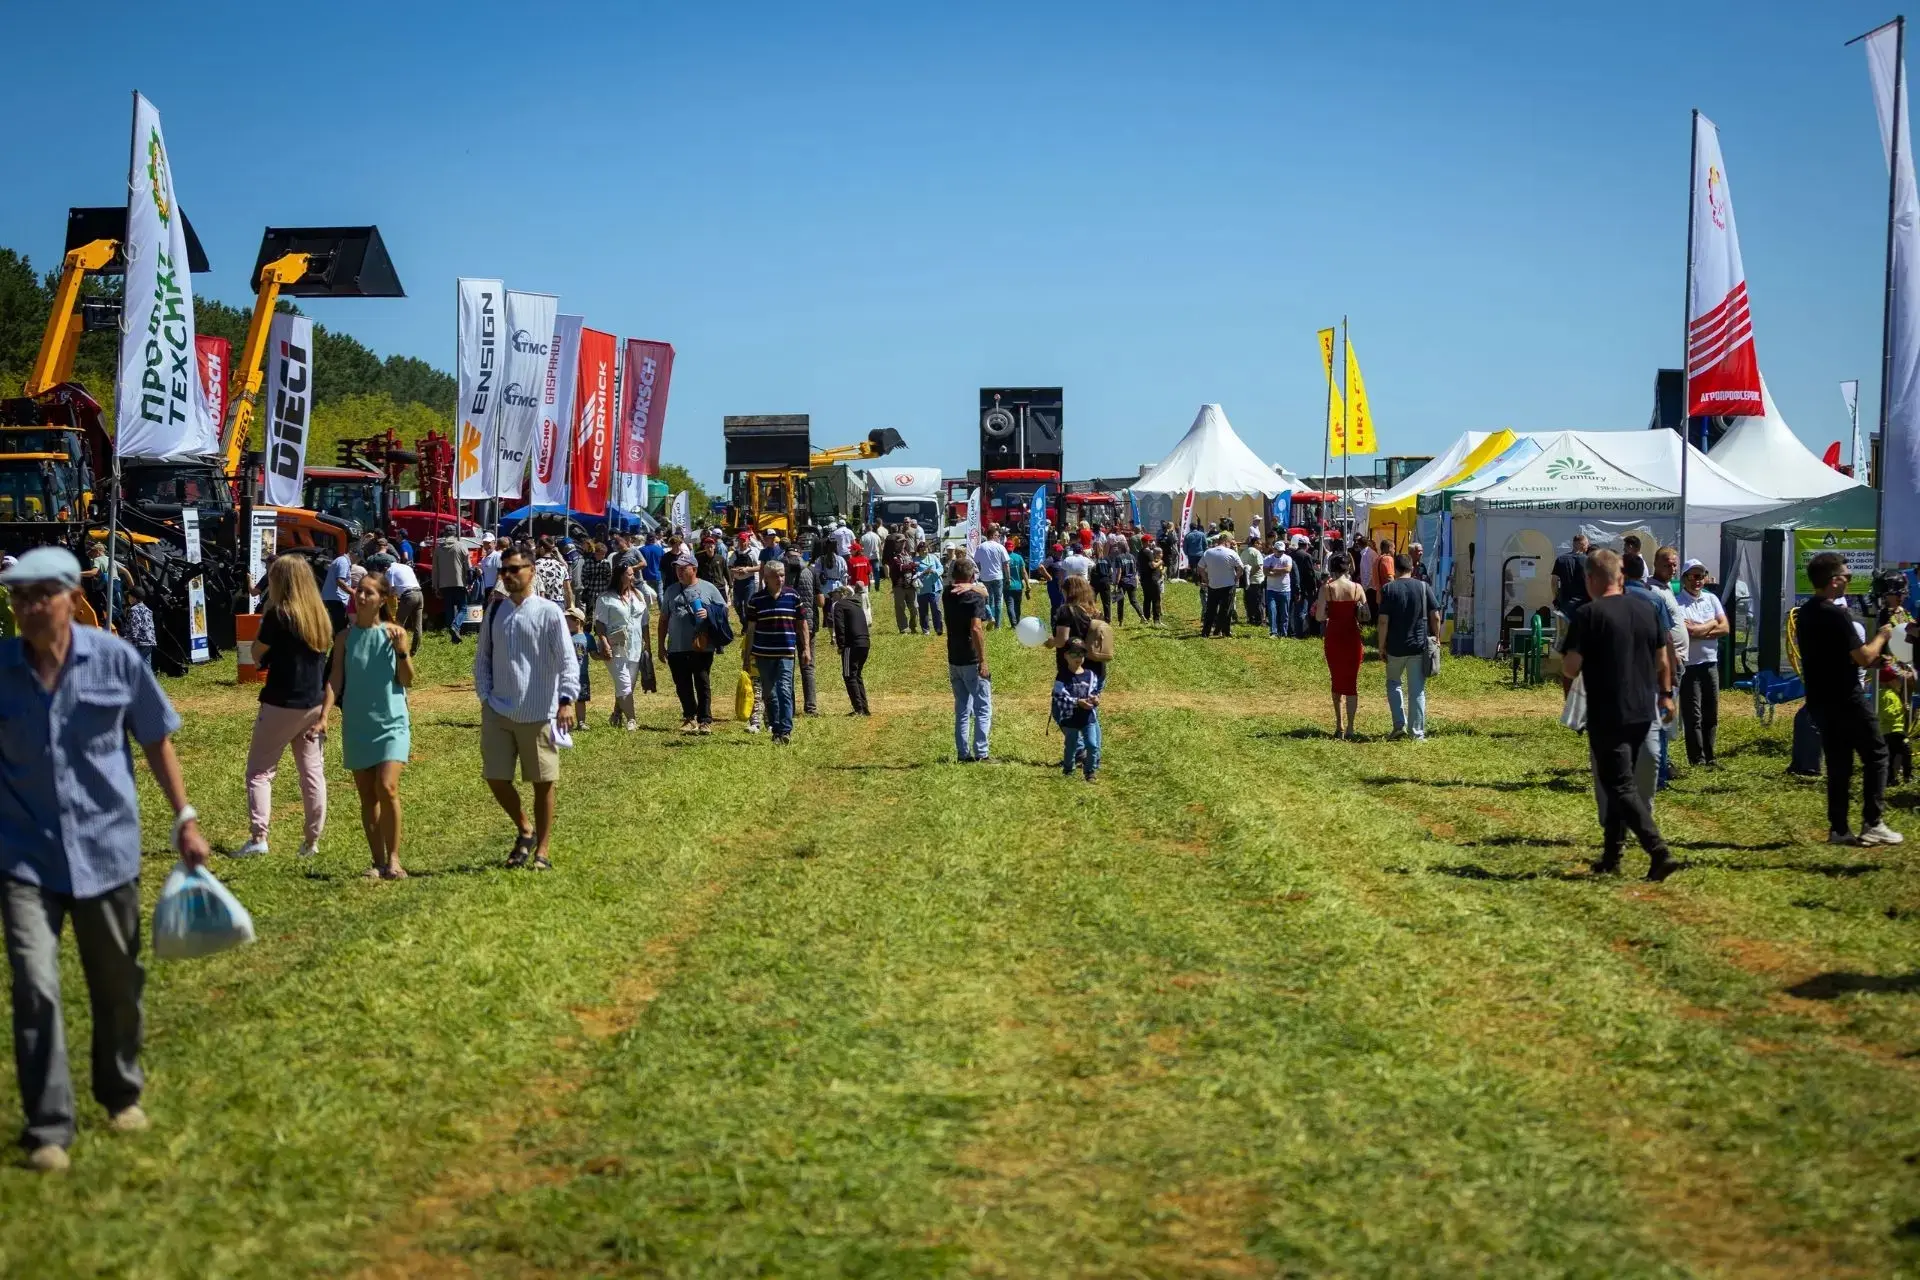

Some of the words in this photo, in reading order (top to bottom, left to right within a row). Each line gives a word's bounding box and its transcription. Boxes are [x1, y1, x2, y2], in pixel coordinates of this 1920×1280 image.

[471, 292, 494, 415] ENSIGN
[522, 341, 548, 355] TMC
[511, 394, 538, 408] TMC
[631, 356, 657, 443] HORSCH
[587, 360, 607, 489] McCORMICK
[538, 419, 551, 475] MASCHIO
[1560, 473, 1607, 483] Century
[1488, 498, 1534, 510] Новый
[1538, 500, 1561, 510] век
[1565, 498, 1675, 512] агротехнологий
